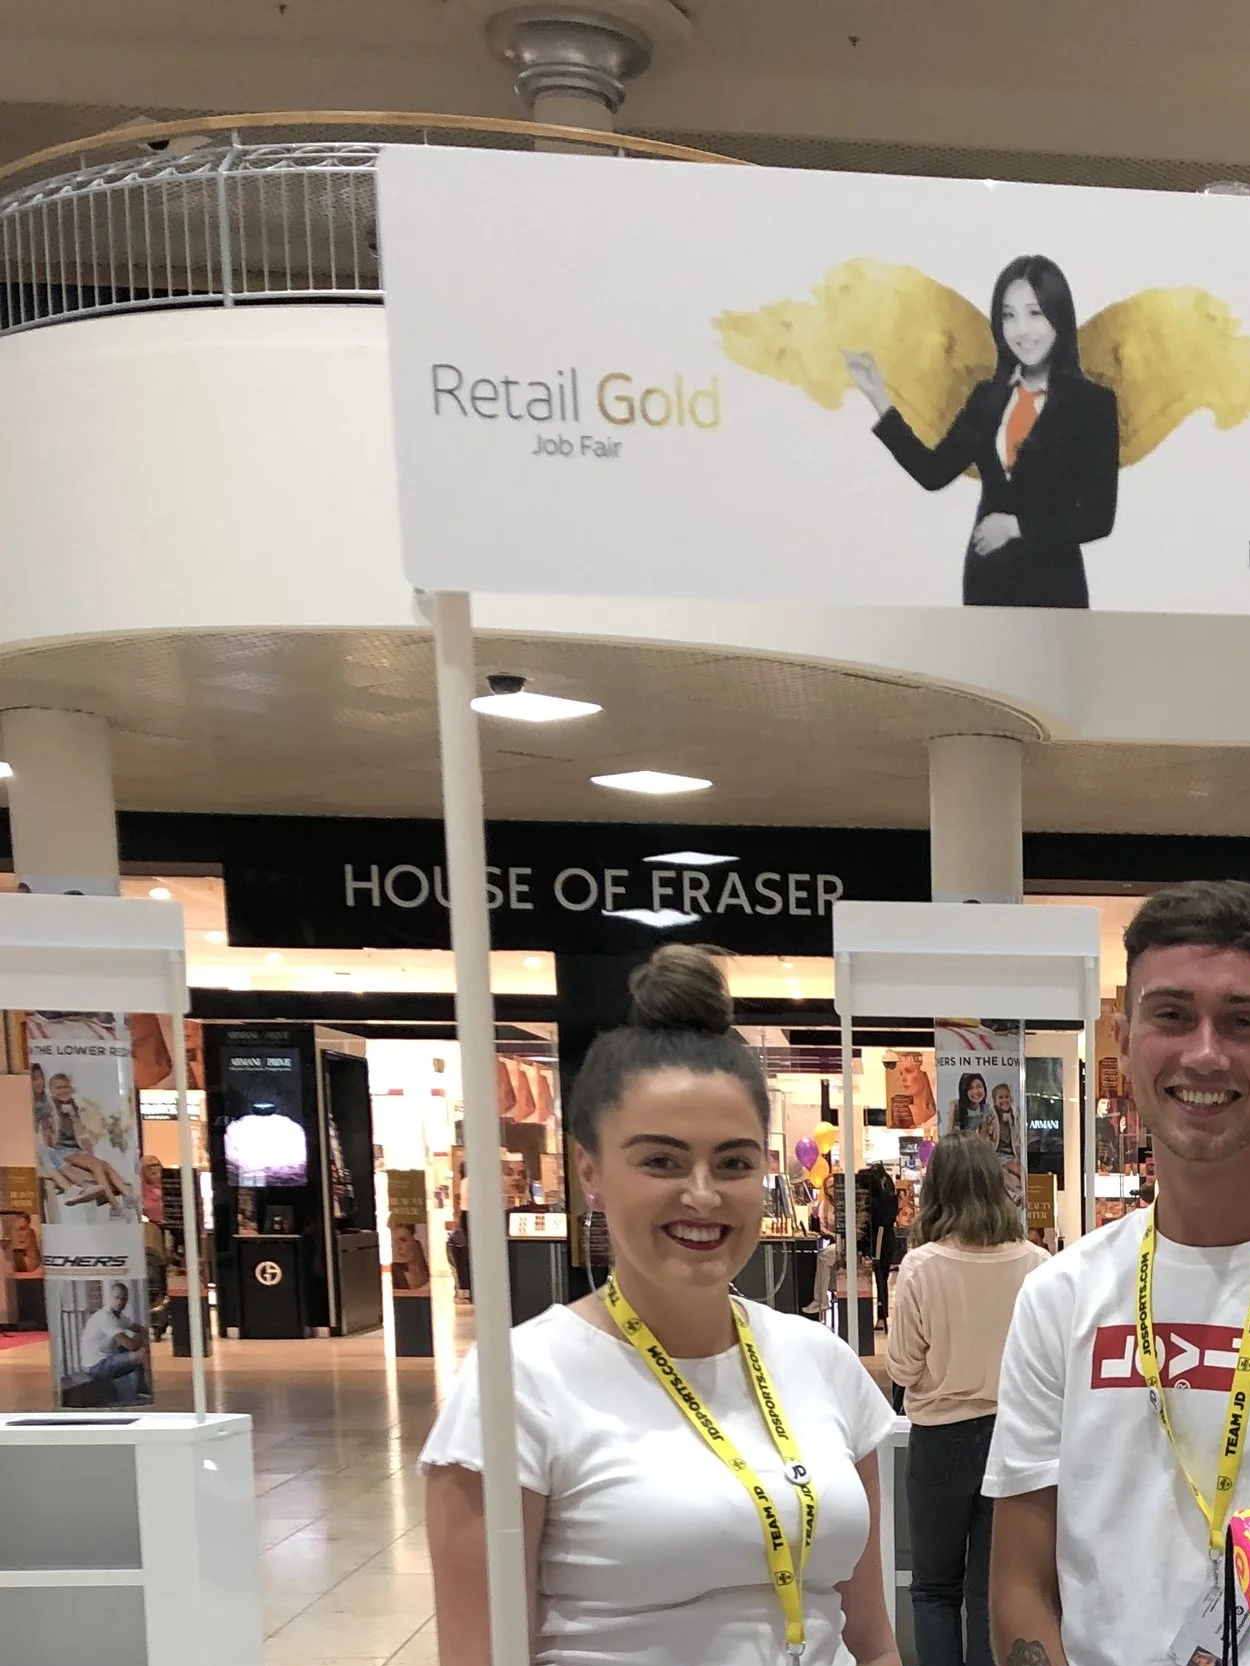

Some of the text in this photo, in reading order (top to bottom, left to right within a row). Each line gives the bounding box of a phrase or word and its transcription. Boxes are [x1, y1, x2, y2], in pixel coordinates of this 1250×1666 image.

[431, 363, 720, 429] Retail Gold
[532, 434, 622, 460] Job Fair
[554, 867, 630, 912] OF
[652, 868, 846, 917] FRASER
[57, 1045, 106, 1057] LOWER
[959, 1057, 971, 1067] IN
[975, 1056, 998, 1067] THE
[1030, 1120, 1059, 1130] ARMANI
[1139, 1252, 1151, 1356] JDSPORTS.COM
[646, 1344, 725, 1443] JDSPORTS.COM
[745, 1342, 790, 1441] JDSPORTS.COM
[1225, 1391, 1246, 1457] TEAM JD
[753, 1485, 785, 1551] TEAM JD
[804, 1504, 815, 1547] TEAM
